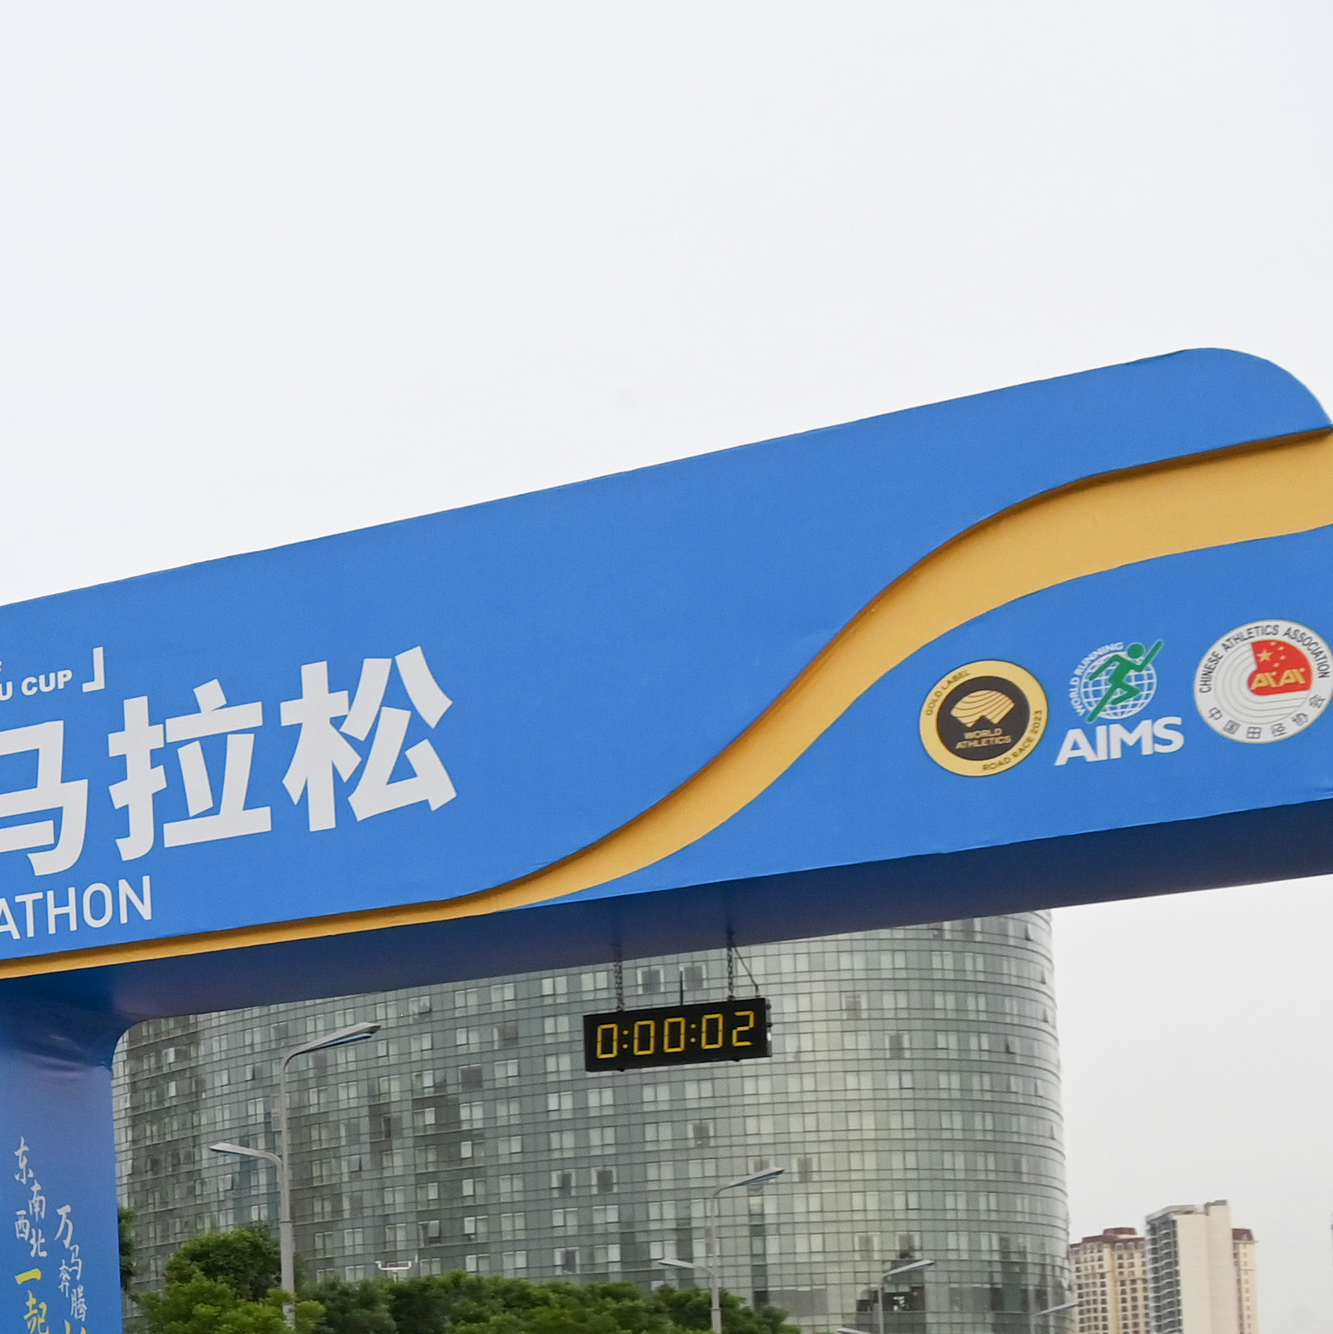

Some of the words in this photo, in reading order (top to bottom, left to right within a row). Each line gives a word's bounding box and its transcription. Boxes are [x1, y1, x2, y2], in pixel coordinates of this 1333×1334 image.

[20, 669, 73, 696] CUP
[1198, 650, 1224, 694] CHINESE
[1221, 624, 1280, 652] ATHLETICS
[1282, 626, 1331, 680] ASSOCIATION
[1054, 716, 1185, 767] AIMS
[596, 1010, 755, 1059] 0:00:02
